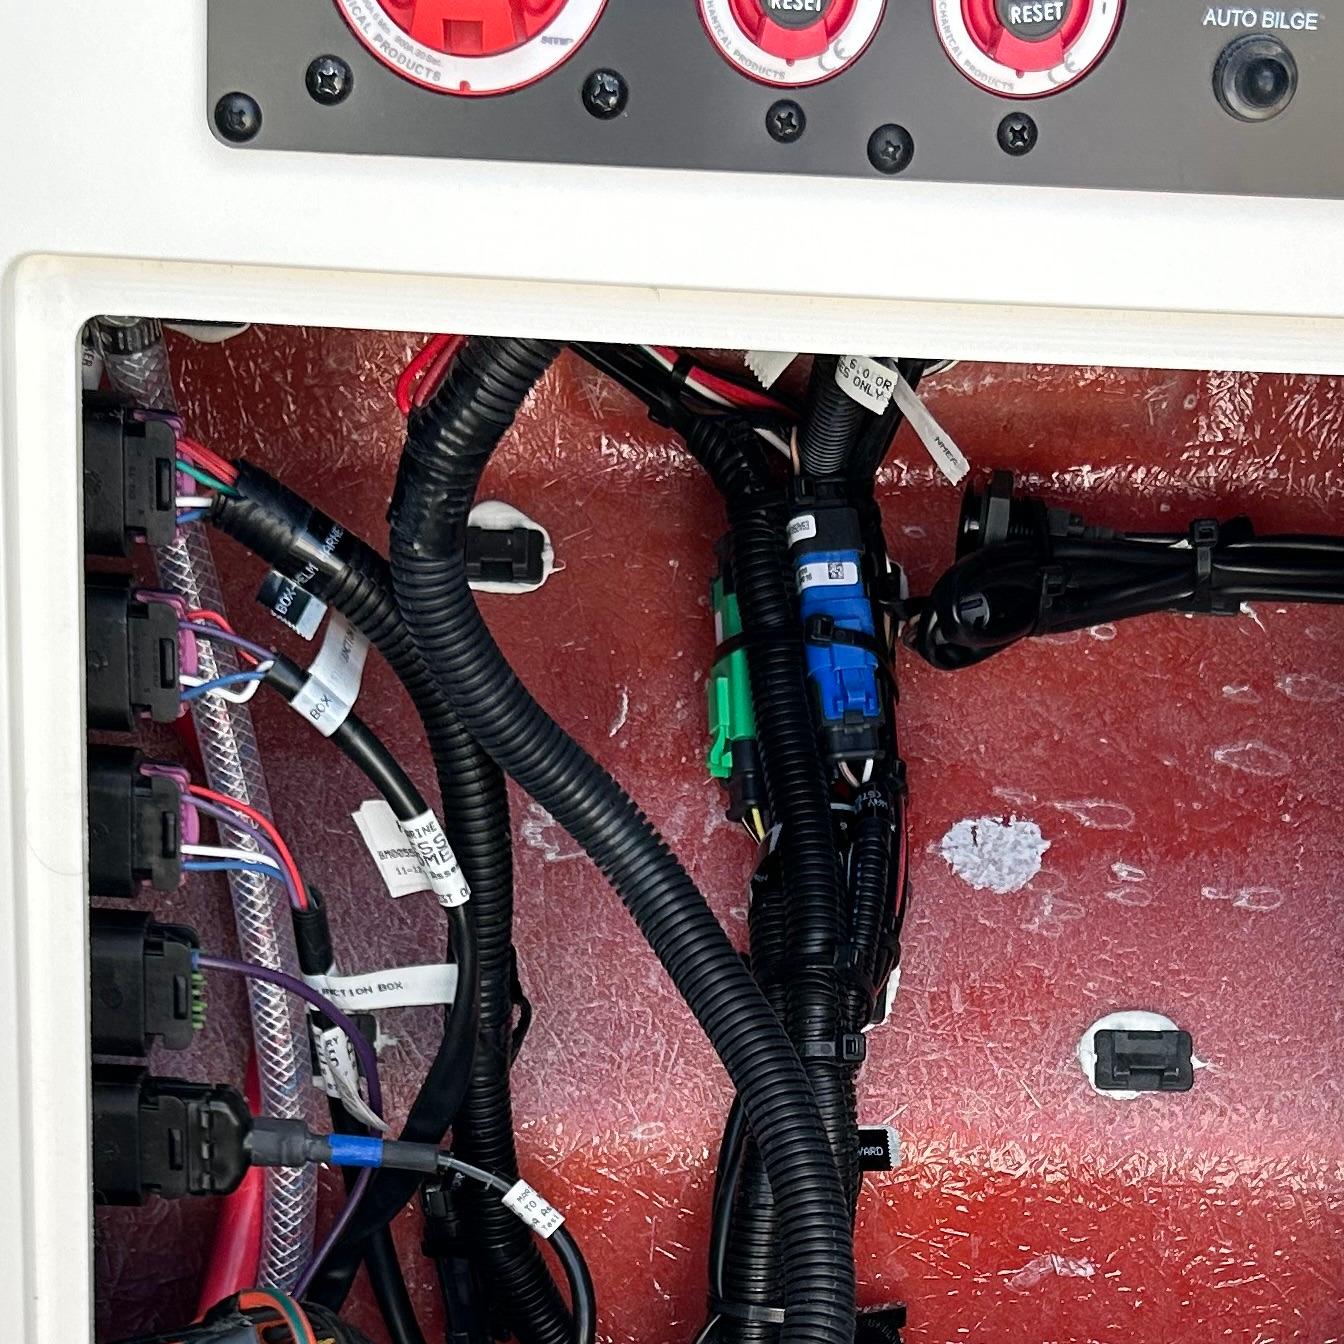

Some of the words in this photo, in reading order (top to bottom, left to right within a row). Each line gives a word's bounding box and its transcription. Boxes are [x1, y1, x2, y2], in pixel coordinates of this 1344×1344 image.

[1010, 2, 1064, 25] RESET
[1202, 8, 1257, 28] AUTO
[1261, 10, 1319, 31] BILGE
[373, 33, 442, 82] PRODUCTS
[732, 48, 787, 80] PRODUCTS
[963, 59, 1016, 91] PRODUCTS
[852, 376, 885, 401] ONLY
[875, 376, 893, 391] OR
[309, 694, 333, 720] BOX
[378, 981, 404, 992] BOX
[523, 1200, 537, 1213] TO
